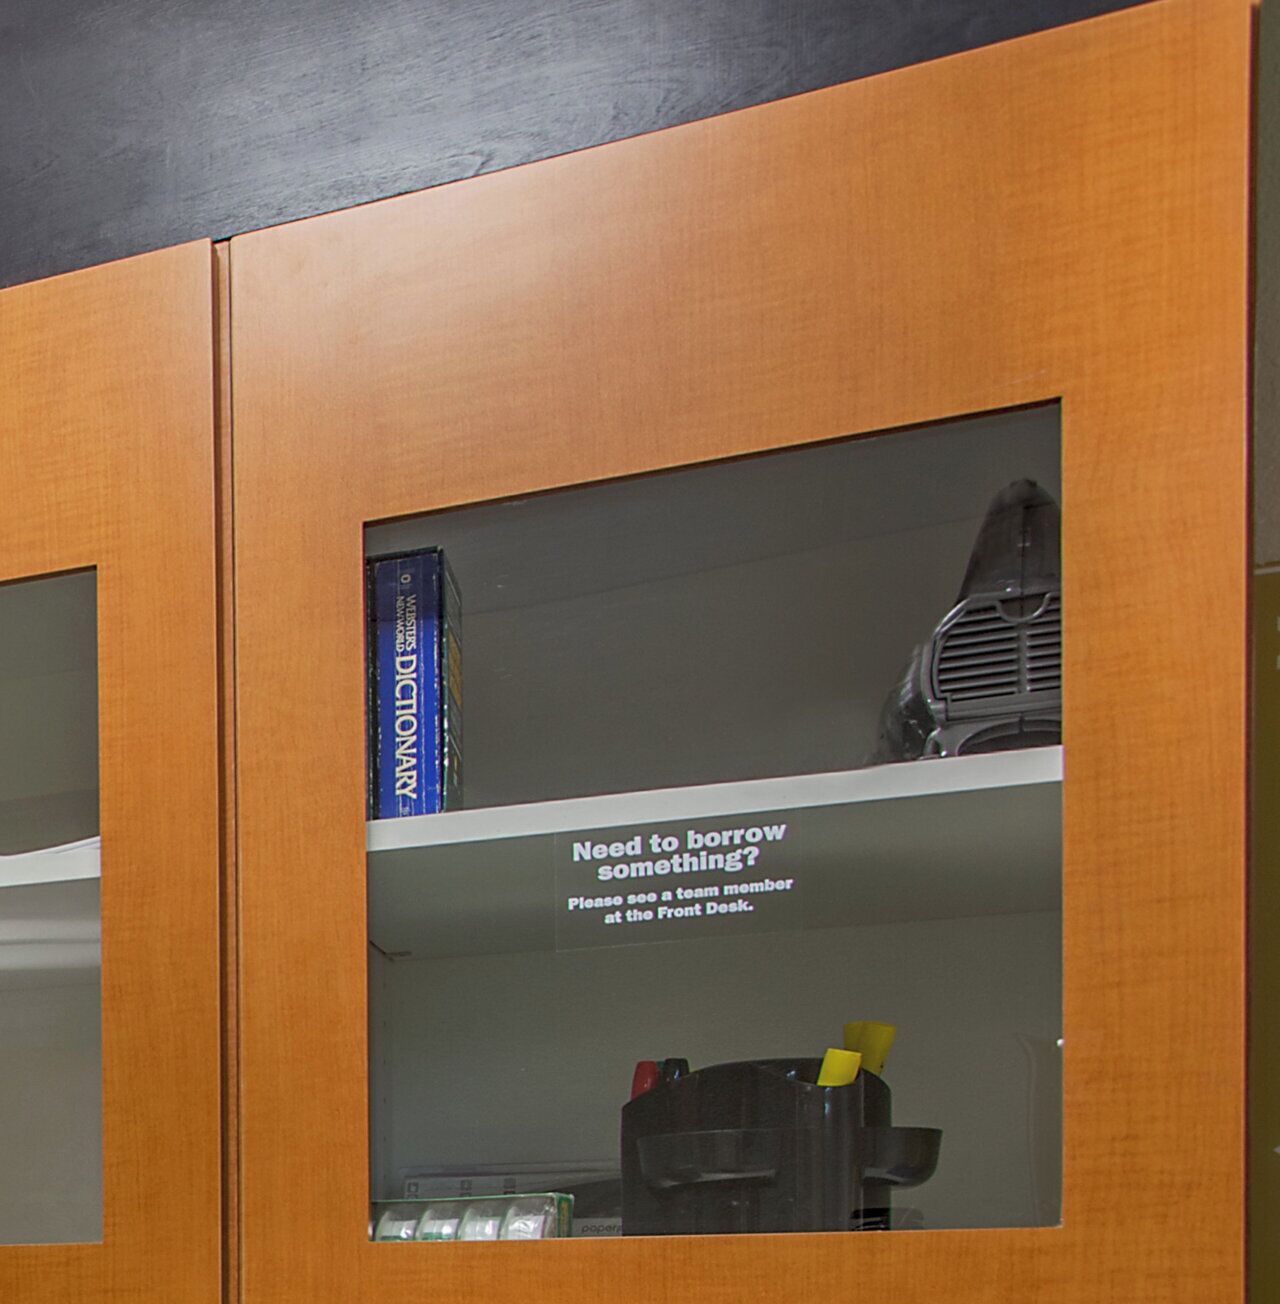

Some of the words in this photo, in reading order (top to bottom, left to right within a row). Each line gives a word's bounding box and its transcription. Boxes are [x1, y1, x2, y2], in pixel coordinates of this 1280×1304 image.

[394, 653, 417, 799] DICTIONARY
[573, 836, 642, 861] Need
[650, 834, 679, 853] to
[687, 824, 786, 849] borrow
[597, 846, 760, 881] something?
[568, 897, 623, 910] Please
[627, 893, 657, 904] see
[661, 890, 672, 901] a
[676, 886, 719, 899] team
[723, 878, 794, 895] member
[604, 911, 622, 924] at
[626, 907, 653, 922] the
[658, 903, 702, 919] Front
[706, 899, 754, 915] Desk.
